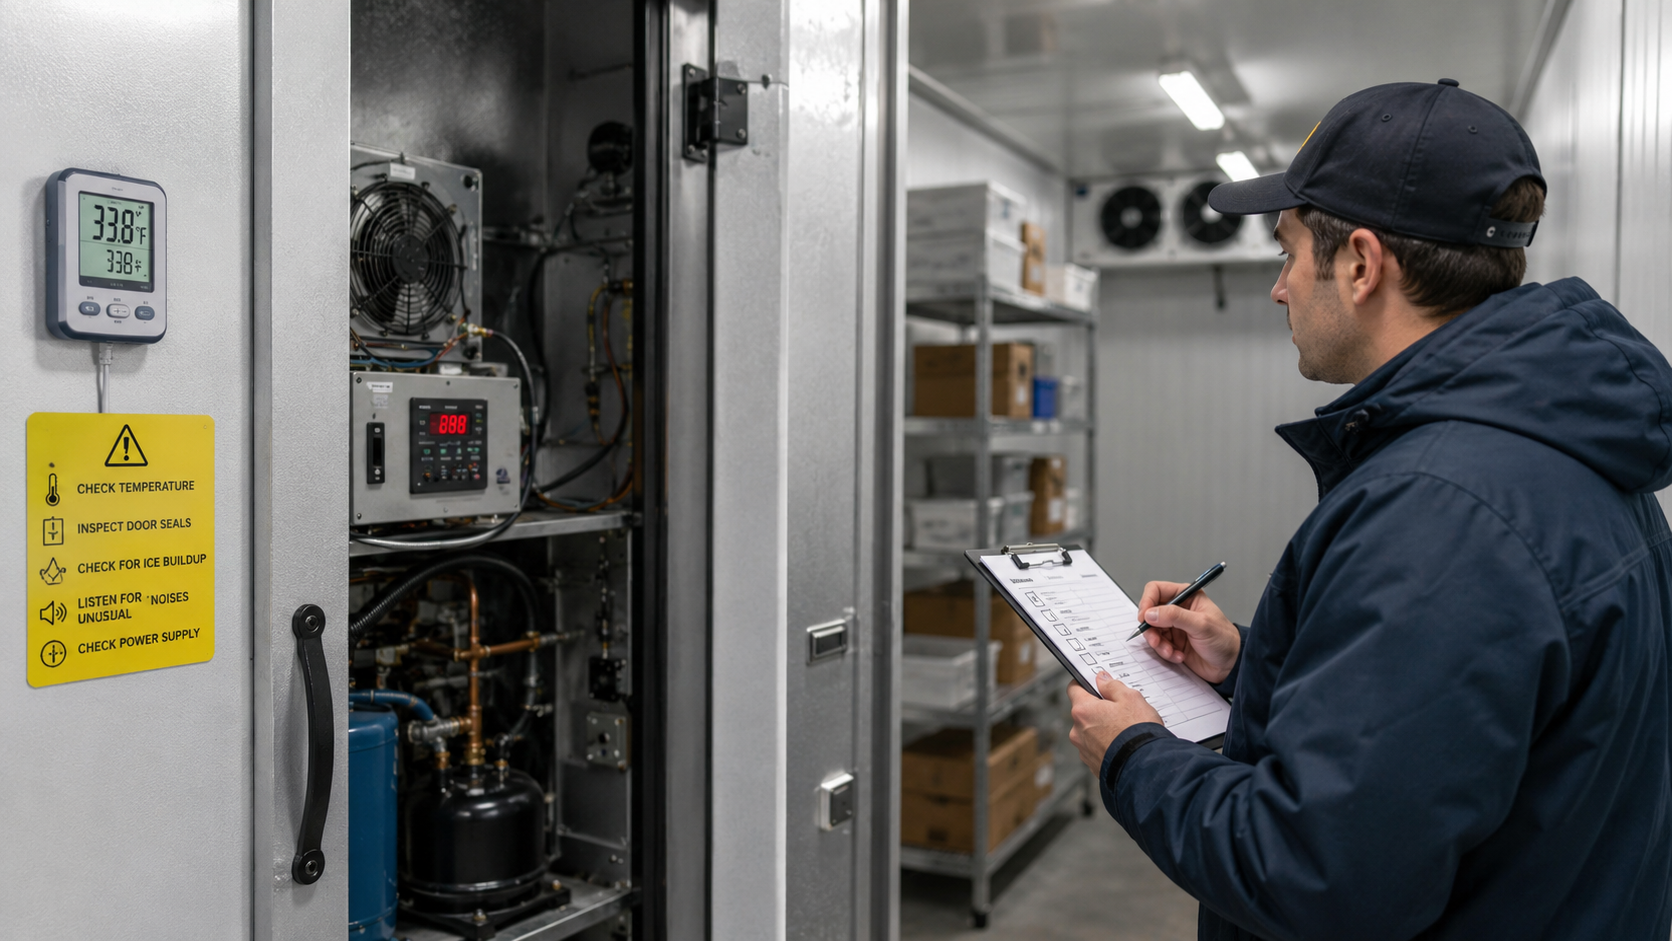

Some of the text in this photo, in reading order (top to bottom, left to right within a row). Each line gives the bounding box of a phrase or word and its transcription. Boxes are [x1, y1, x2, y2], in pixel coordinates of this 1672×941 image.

[77, 480, 195, 495] CHECK TEMPERATURE
[77, 517, 191, 534] INSPECT DOOR SEALS
[77, 553, 207, 574] CHECK FOR ICE BUILDUP
[78, 594, 117, 609] LISTEN
[120, 592, 142, 604] FOR
[78, 608, 132, 624] UNUSUAL
[78, 627, 200, 654] CHECK POWER SUPPLY
